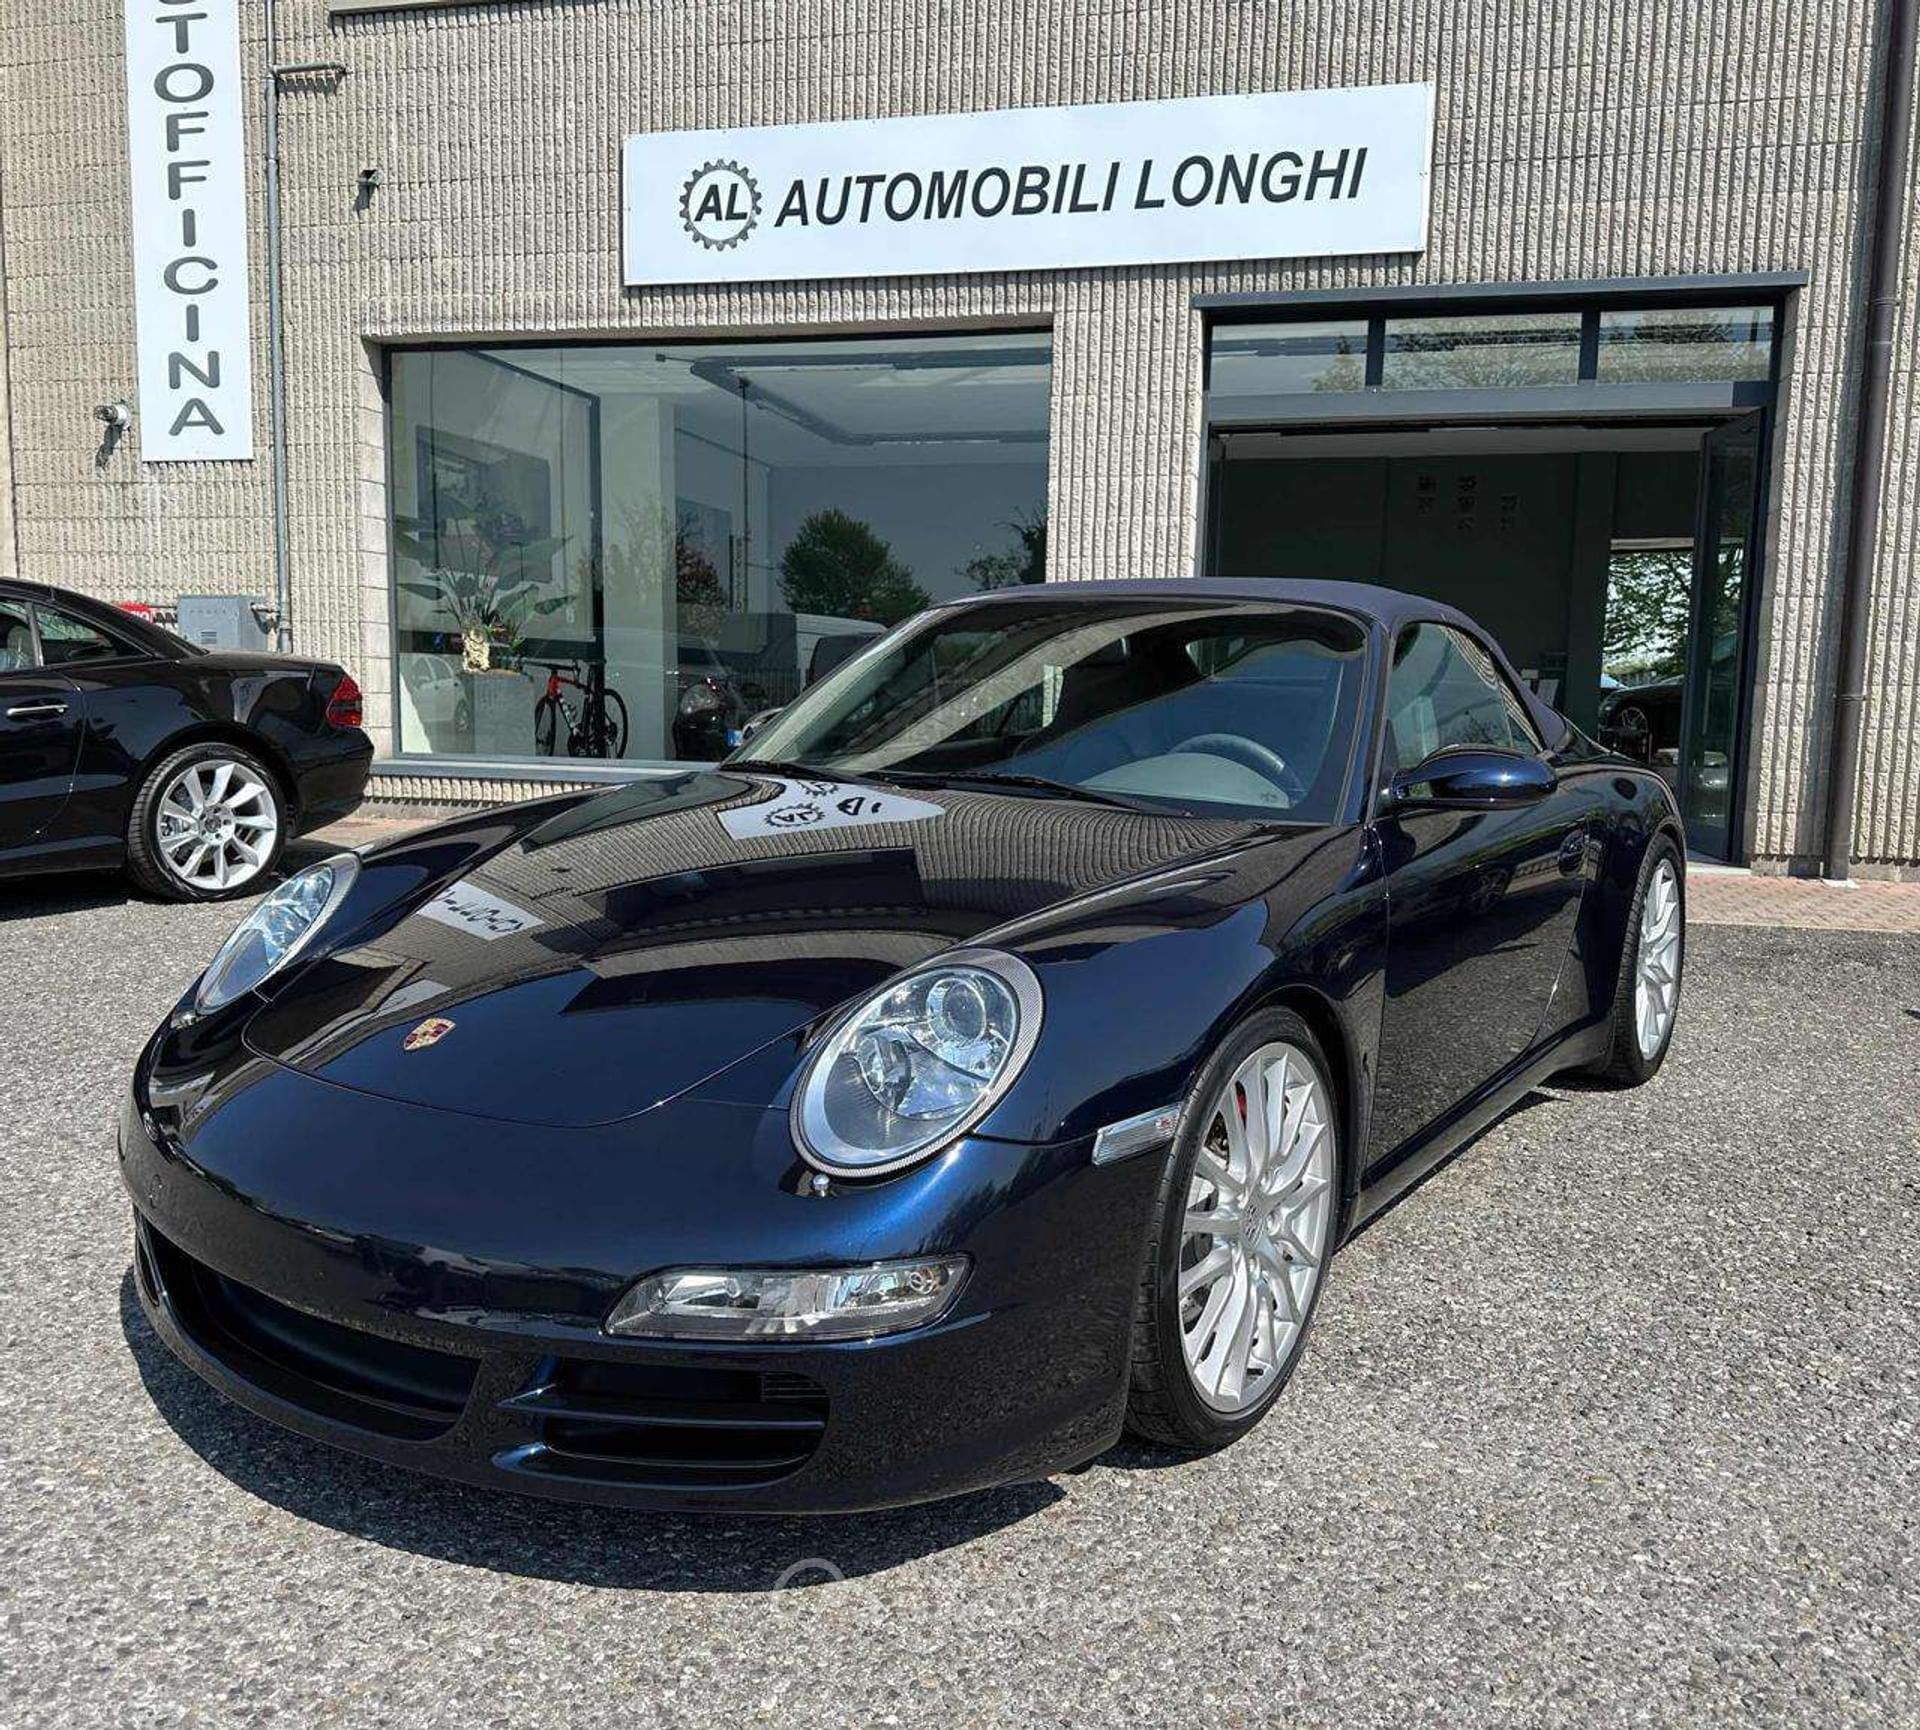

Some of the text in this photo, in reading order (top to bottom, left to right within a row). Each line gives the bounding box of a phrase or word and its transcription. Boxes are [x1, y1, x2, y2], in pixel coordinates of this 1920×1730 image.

[154, 0, 224, 436] TOFFICINA
[694, 184, 749, 222] AL
[774, 147, 1368, 228] AUTOMOBILI LONGHI
